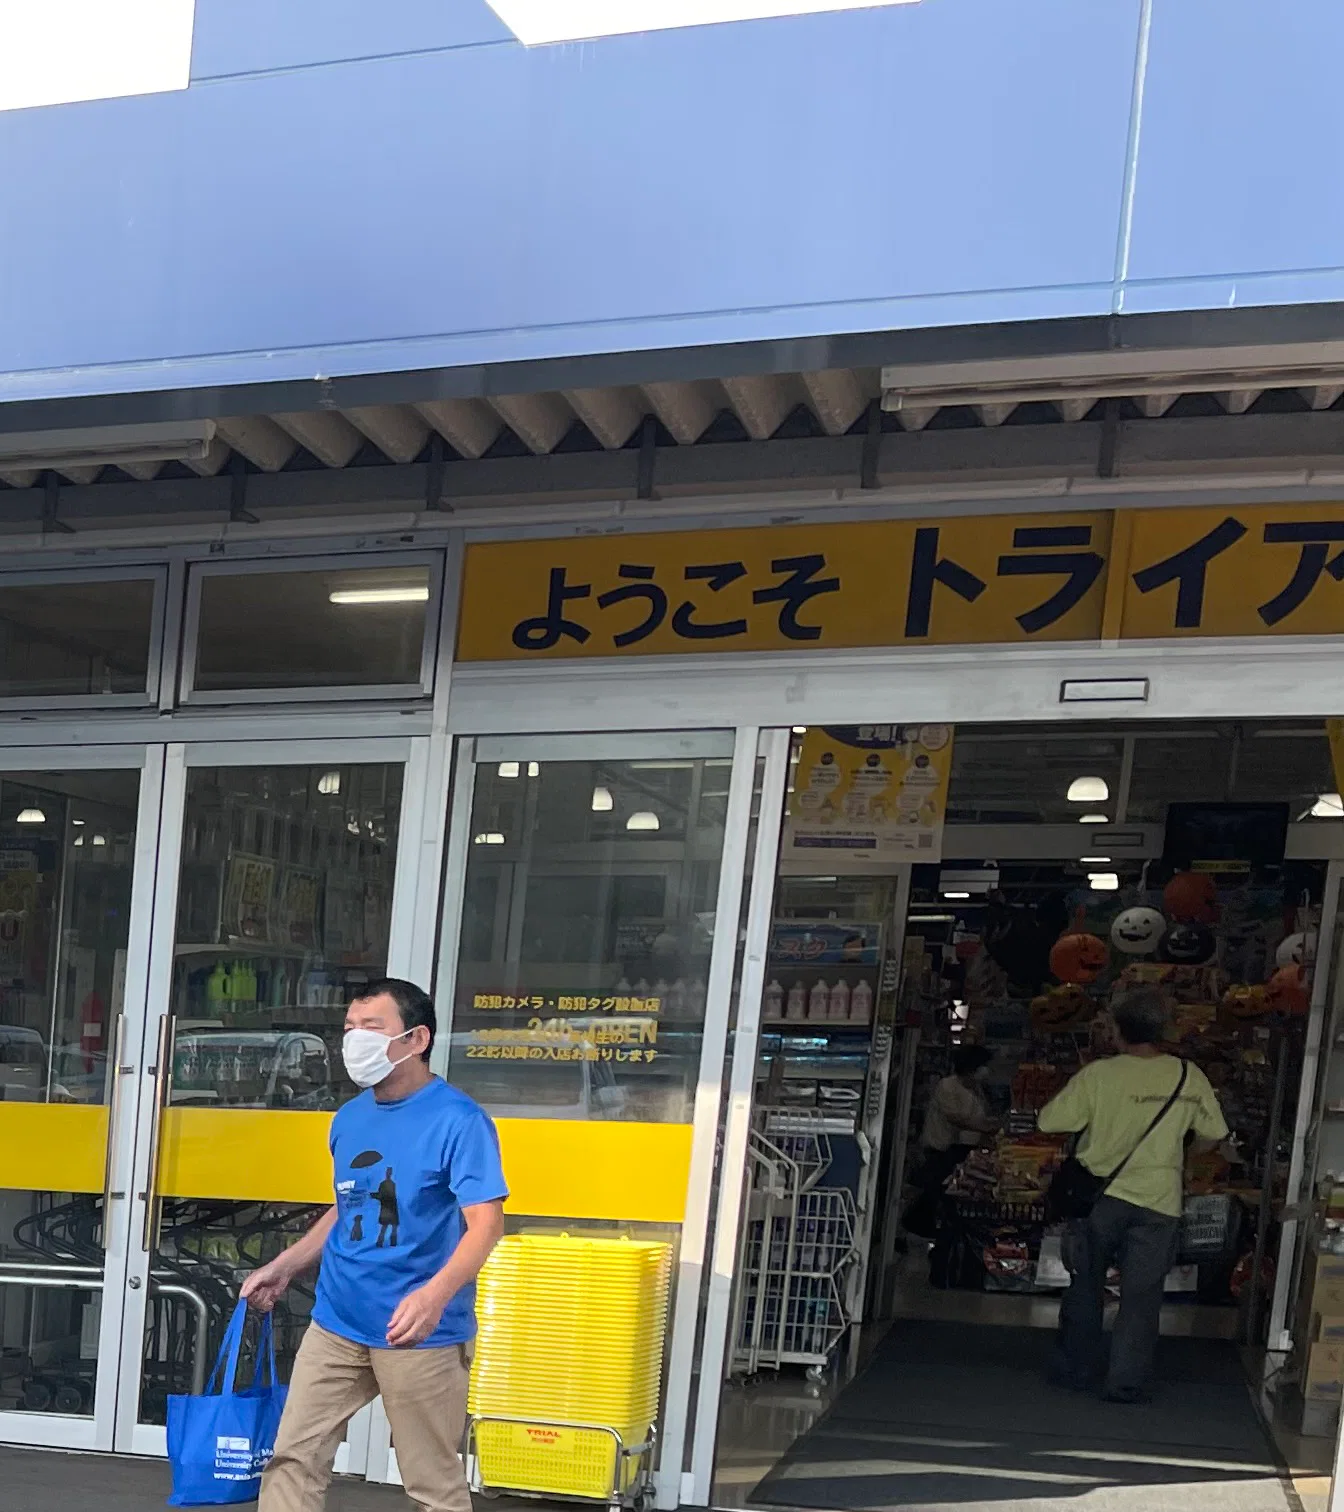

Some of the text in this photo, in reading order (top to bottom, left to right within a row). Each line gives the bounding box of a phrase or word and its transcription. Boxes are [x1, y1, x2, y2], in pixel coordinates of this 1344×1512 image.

[512, 516, 1344, 649] ようこそ トライア
[526, 1428, 562, 1438] TRIAL
